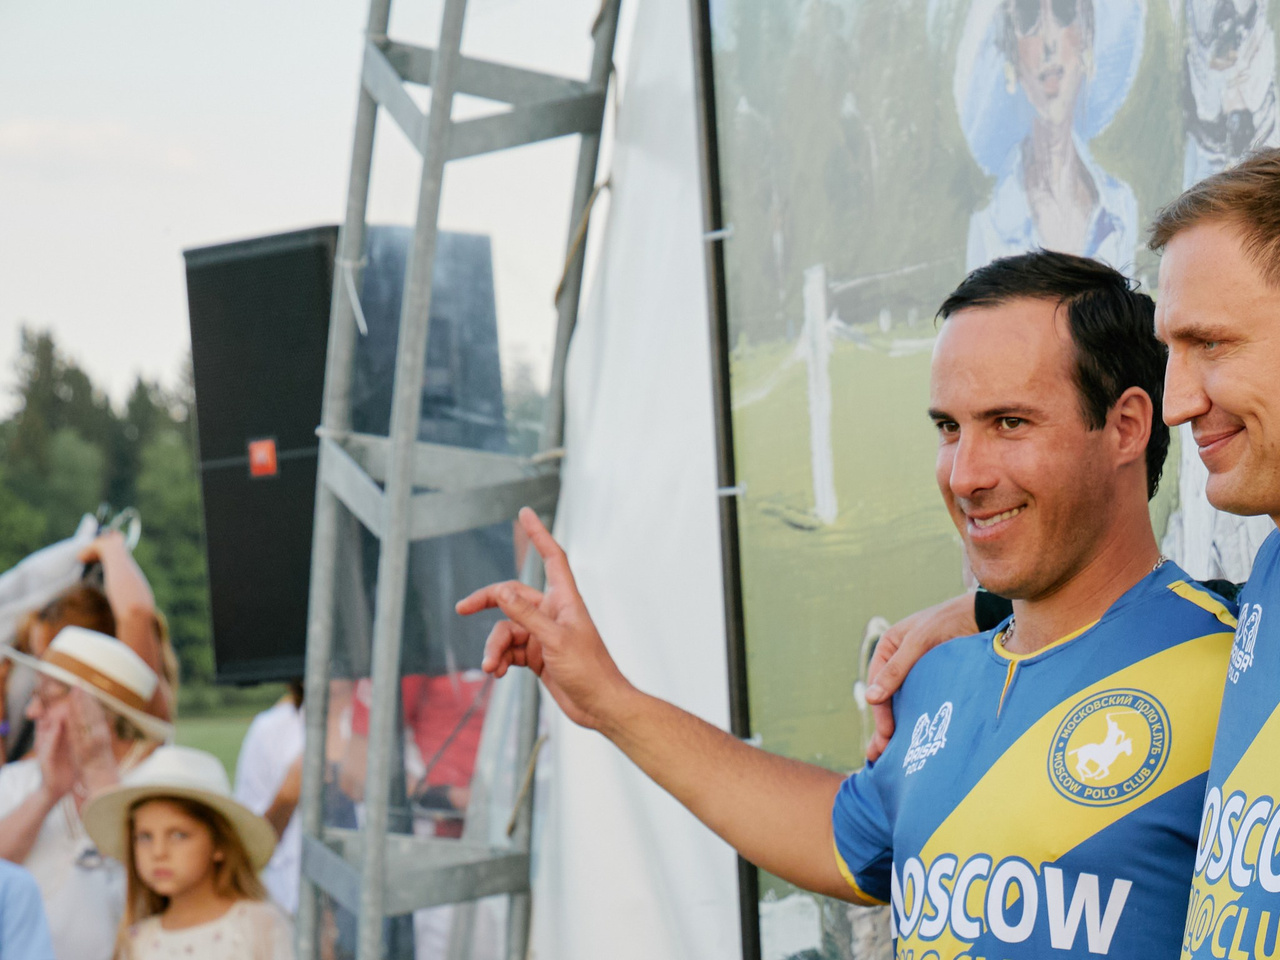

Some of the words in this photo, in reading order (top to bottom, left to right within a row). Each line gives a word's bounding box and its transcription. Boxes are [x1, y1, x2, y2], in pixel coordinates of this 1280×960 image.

[1061, 695, 1134, 739] МОСКОВСКИЙ
[1134, 699, 1159, 724] ПОЛО
[1151, 722, 1163, 755] КЛУБ
[1054, 751, 1083, 794] MOSCOW
[1084, 787, 1118, 799] POLO
[1122, 767, 1152, 792] CLUB
